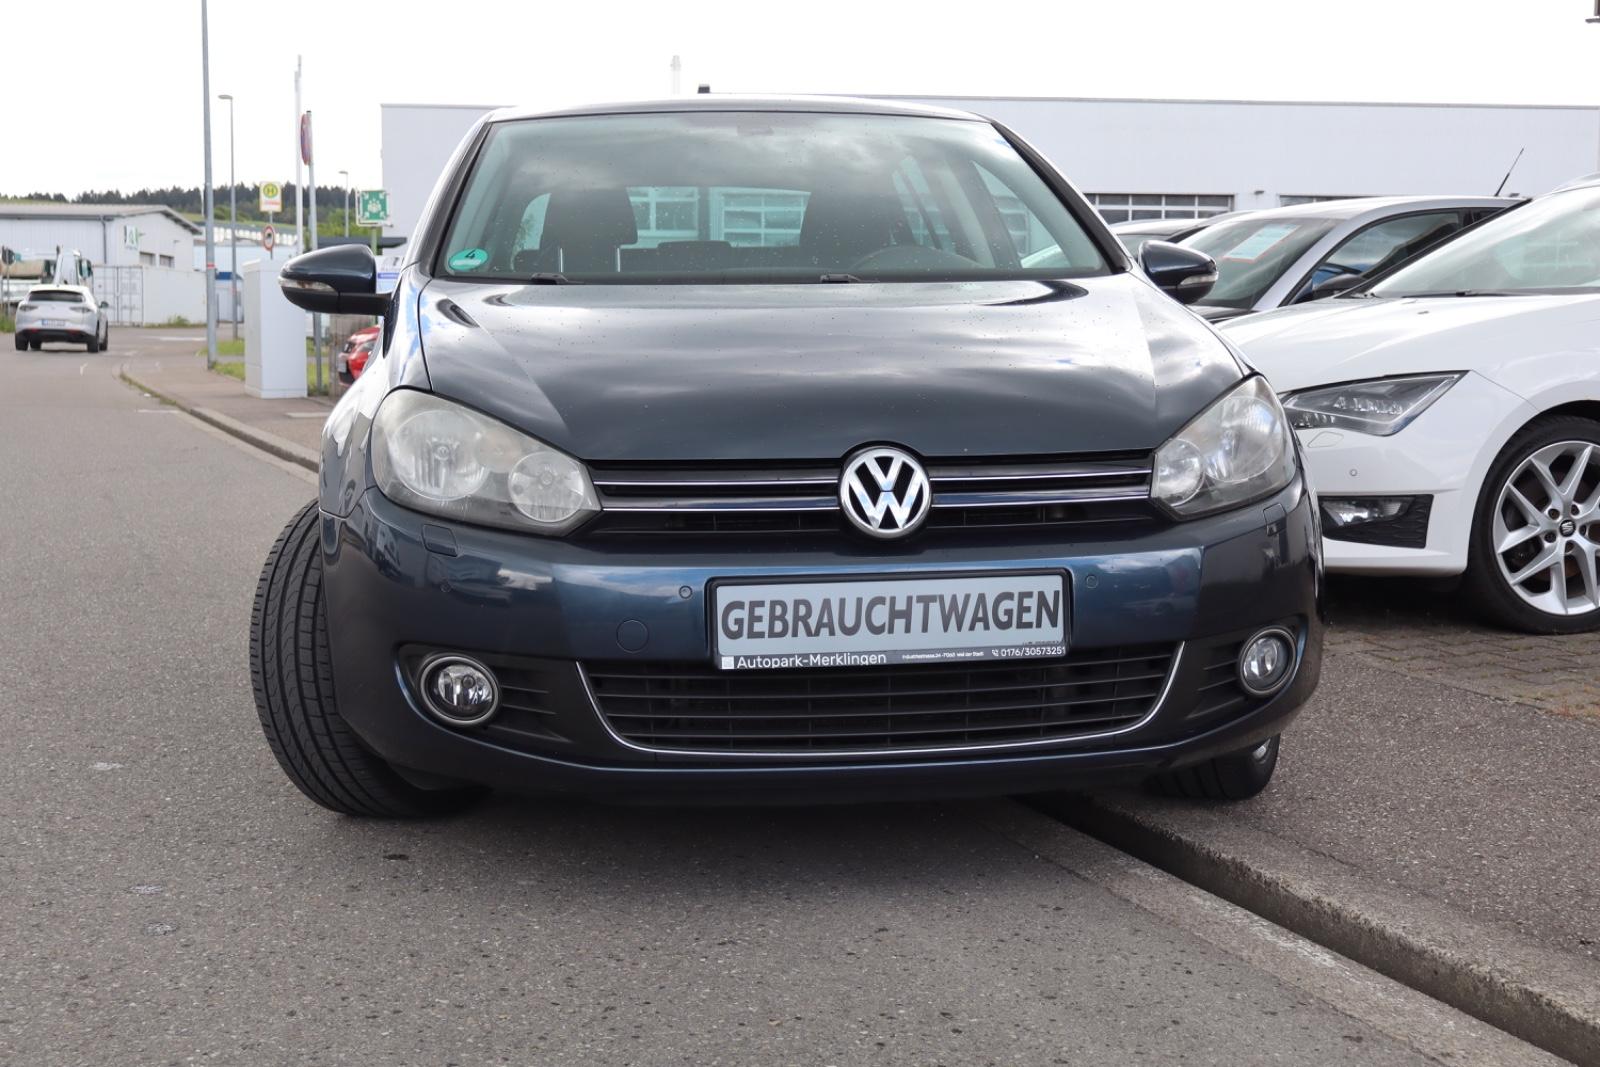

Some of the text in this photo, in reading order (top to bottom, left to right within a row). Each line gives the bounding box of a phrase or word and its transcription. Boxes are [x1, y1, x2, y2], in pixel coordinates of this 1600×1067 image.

[843, 449, 929, 536] VW
[721, 589, 1061, 640] GEBRAUCHTWAGEN
[736, 653, 887, 670] Autopark-Merklingen
